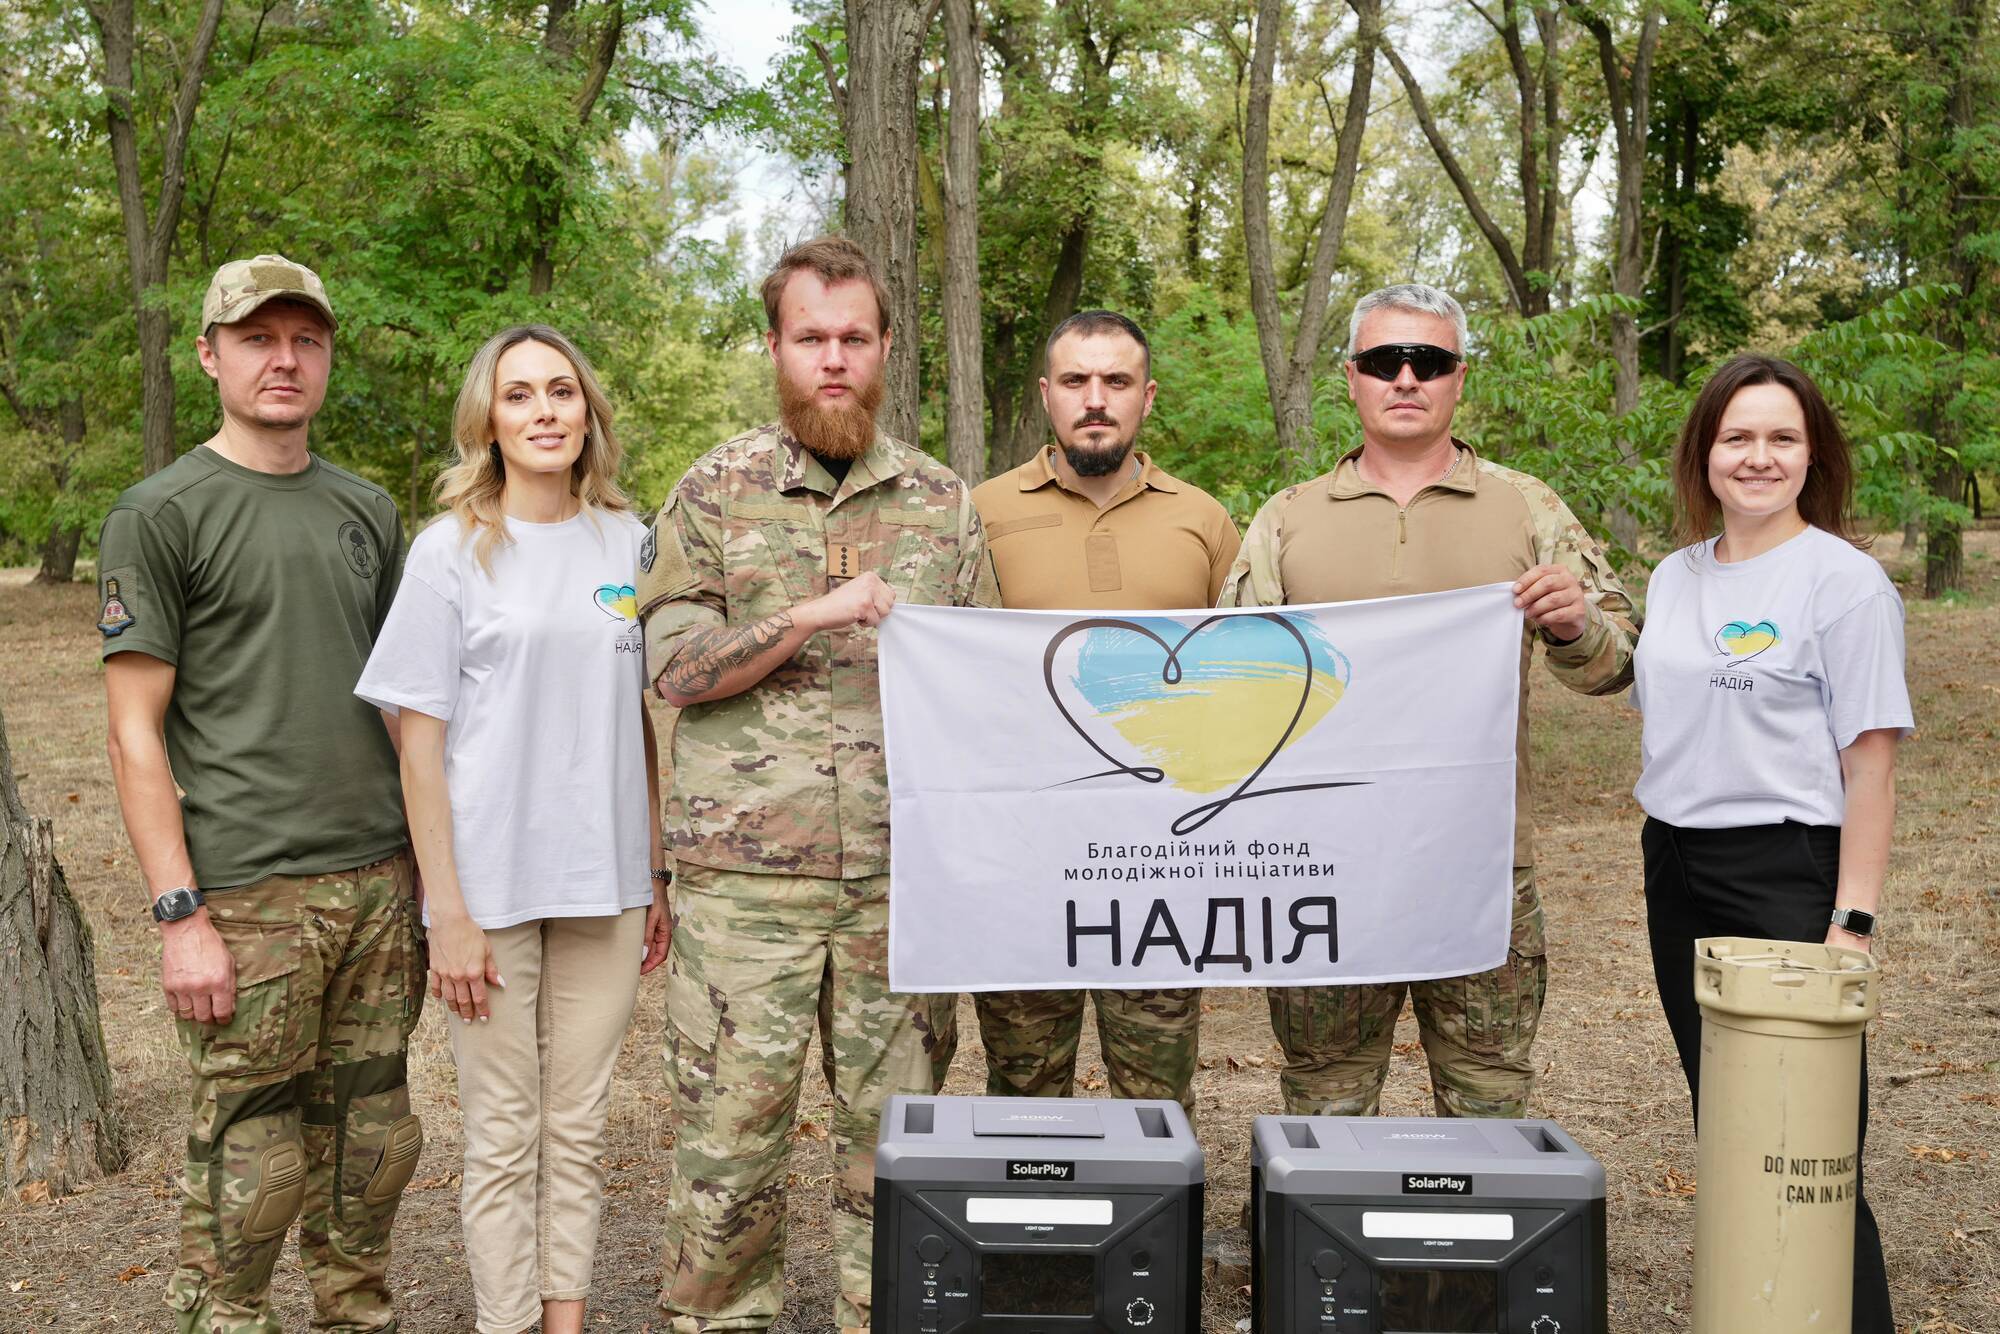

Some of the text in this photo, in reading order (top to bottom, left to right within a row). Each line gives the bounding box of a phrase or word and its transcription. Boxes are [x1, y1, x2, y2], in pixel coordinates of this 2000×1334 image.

[1709, 676, 1754, 691] НАДІЯ
[1088, 840, 1310, 860] Благодійний фонд
[1064, 861, 1335, 882] молодіжної ініціативи
[1066, 896, 1339, 973] НАДІЯ
[1012, 1163, 1069, 1178] SolarPlay
[1764, 1155, 1785, 1174] DO
[1790, 1158, 1818, 1178] NOT
[1408, 1177, 1466, 1192] SolarPlay
[1786, 1185, 1815, 1203] CAN
[1820, 1186, 1833, 1203] IN
[1835, 1184, 1843, 1202] A
